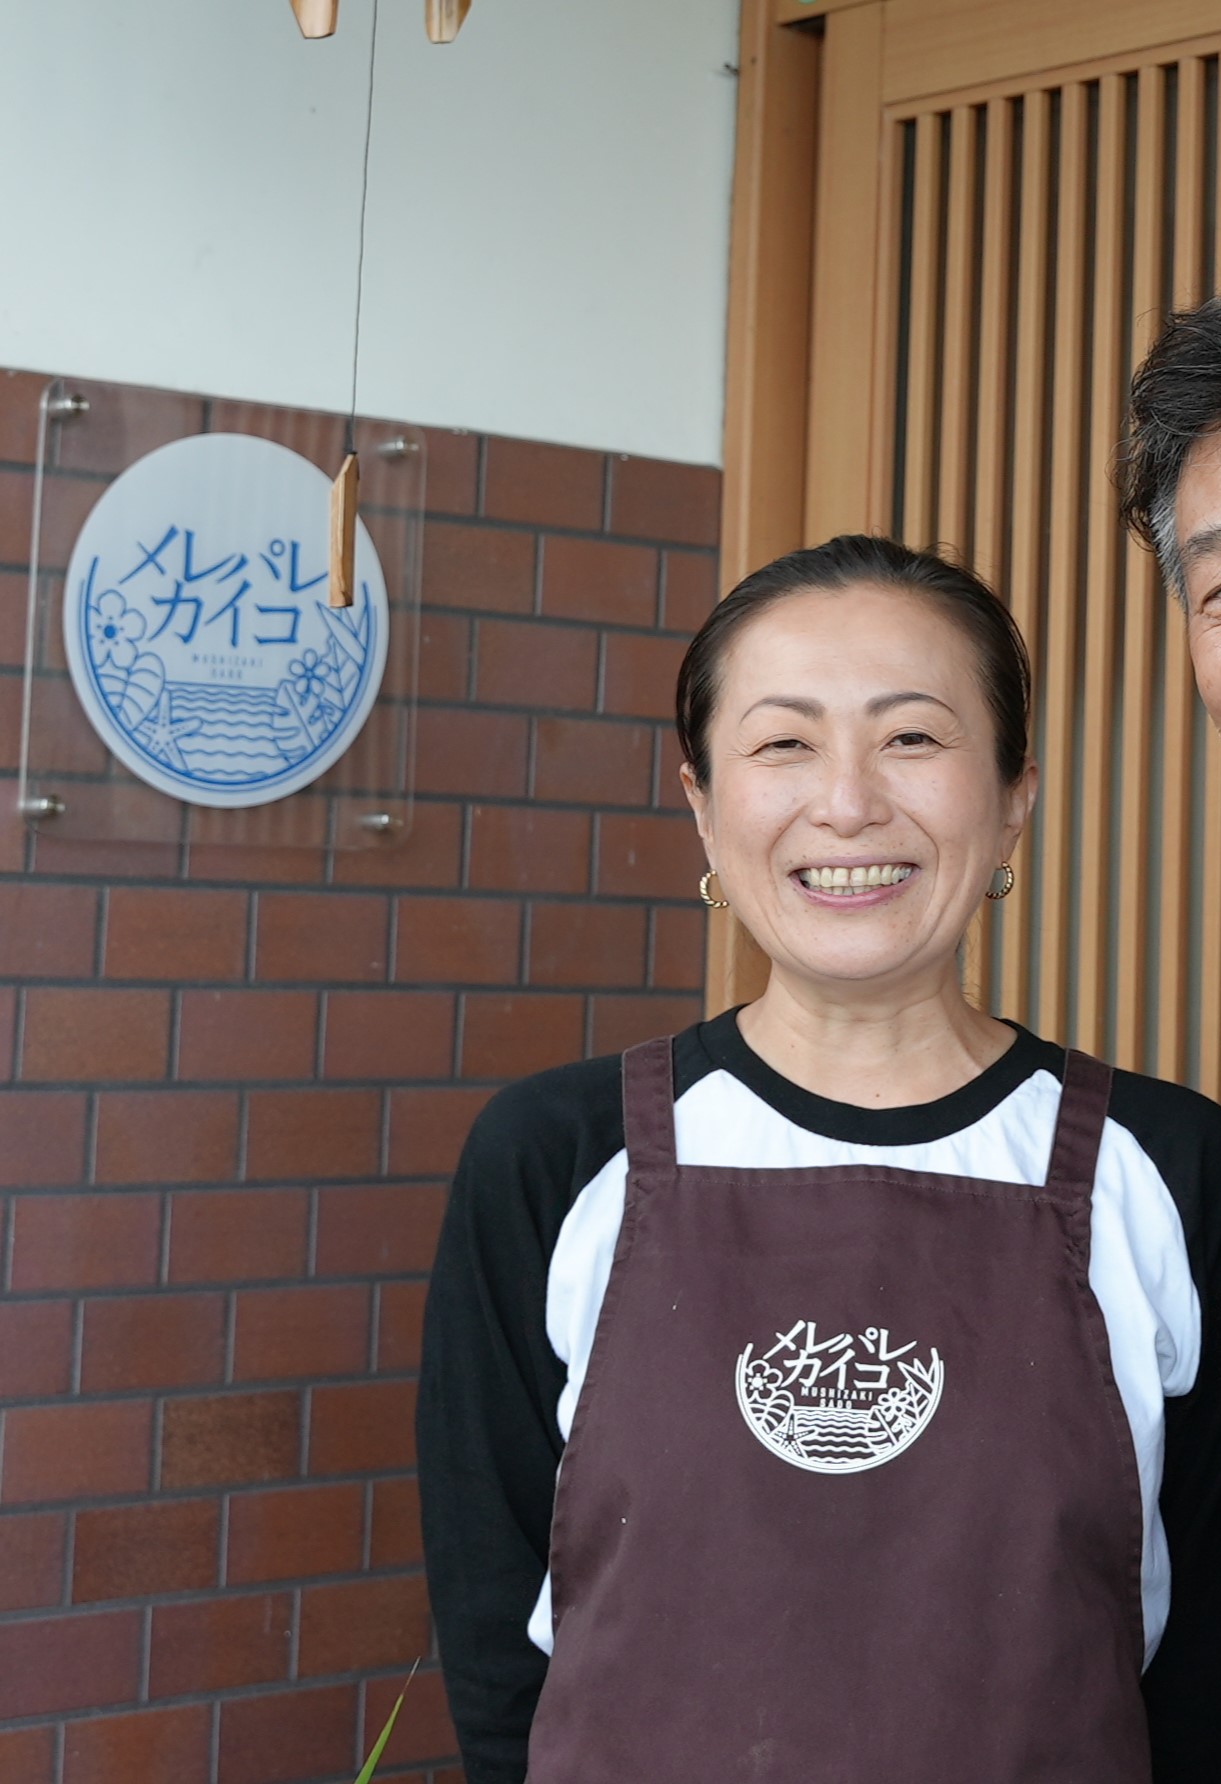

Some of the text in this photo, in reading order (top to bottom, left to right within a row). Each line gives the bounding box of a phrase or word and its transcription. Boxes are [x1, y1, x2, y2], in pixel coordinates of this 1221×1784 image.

[147, 579, 300, 647] カイコ
[762, 1319, 917, 1361] メレパレ
[780, 1348, 890, 1390] カイコ
[800, 1386, 873, 1402] MUSHIZAKI
[819, 1398, 853, 1410] SADO
